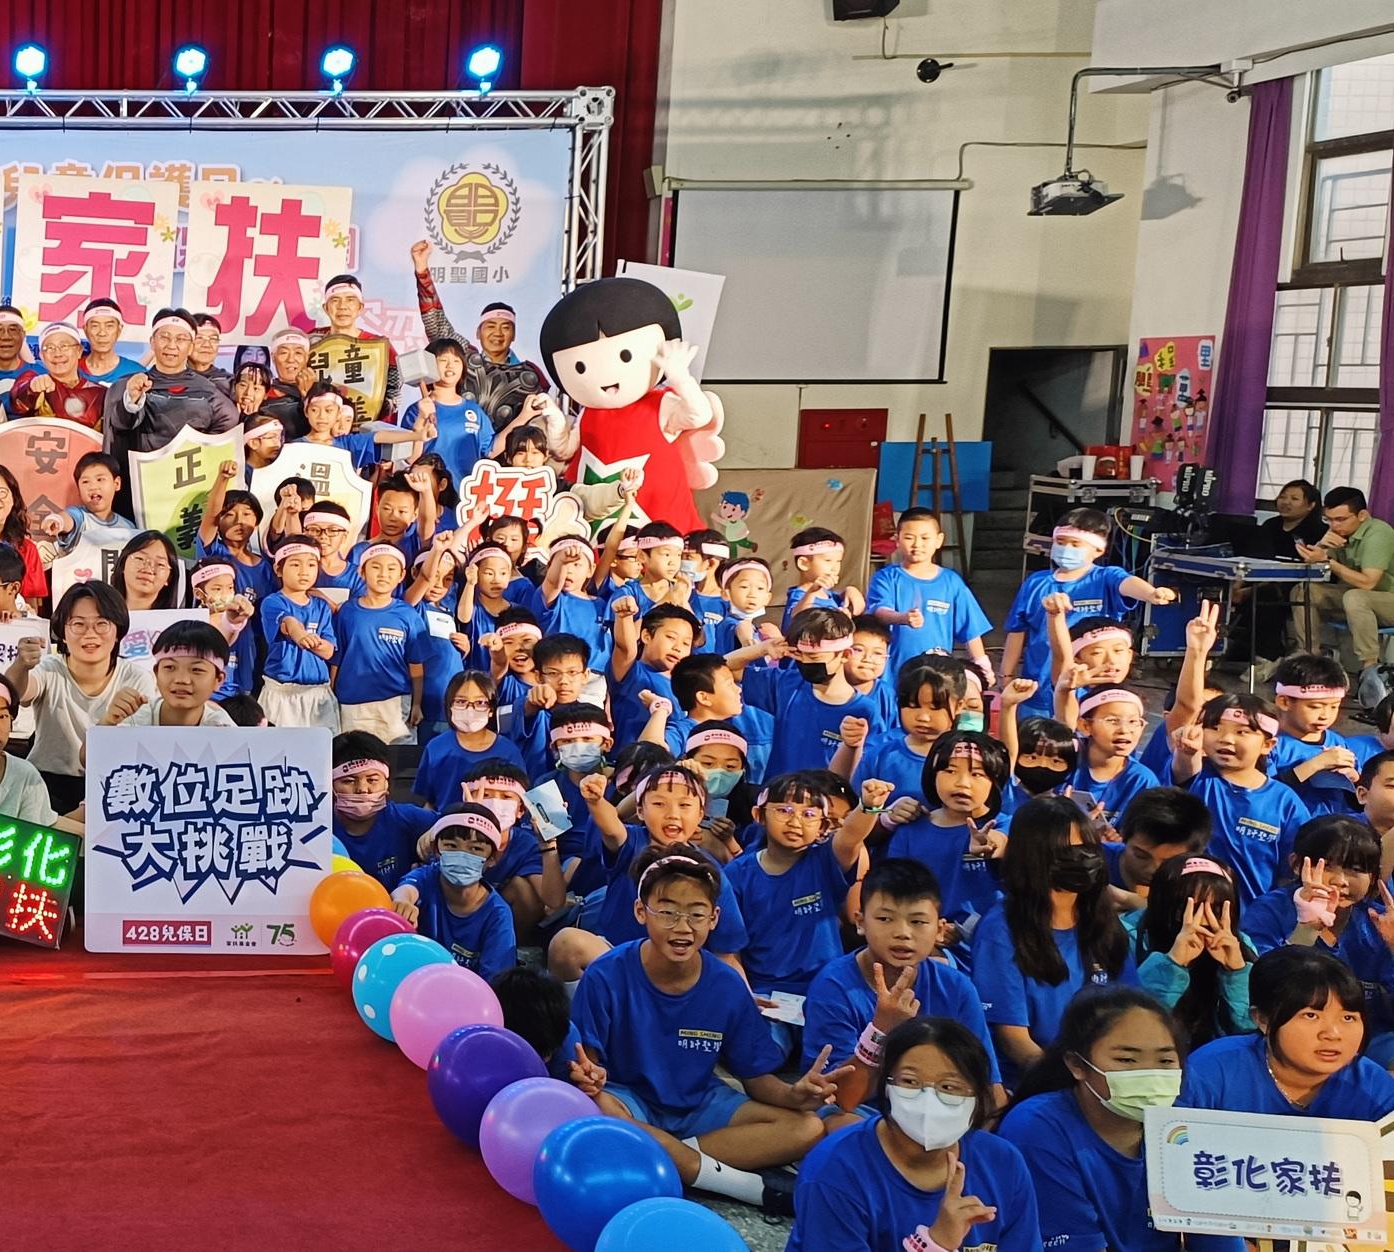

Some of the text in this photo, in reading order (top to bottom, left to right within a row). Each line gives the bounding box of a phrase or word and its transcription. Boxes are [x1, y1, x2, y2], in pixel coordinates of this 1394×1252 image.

[105, 763, 316, 818] 數位足跡
[123, 823, 289, 874] 大挑戰
[125, 925, 208, 942] 428兒保日
[1193, 1150, 1341, 1196] 彰化家扶
